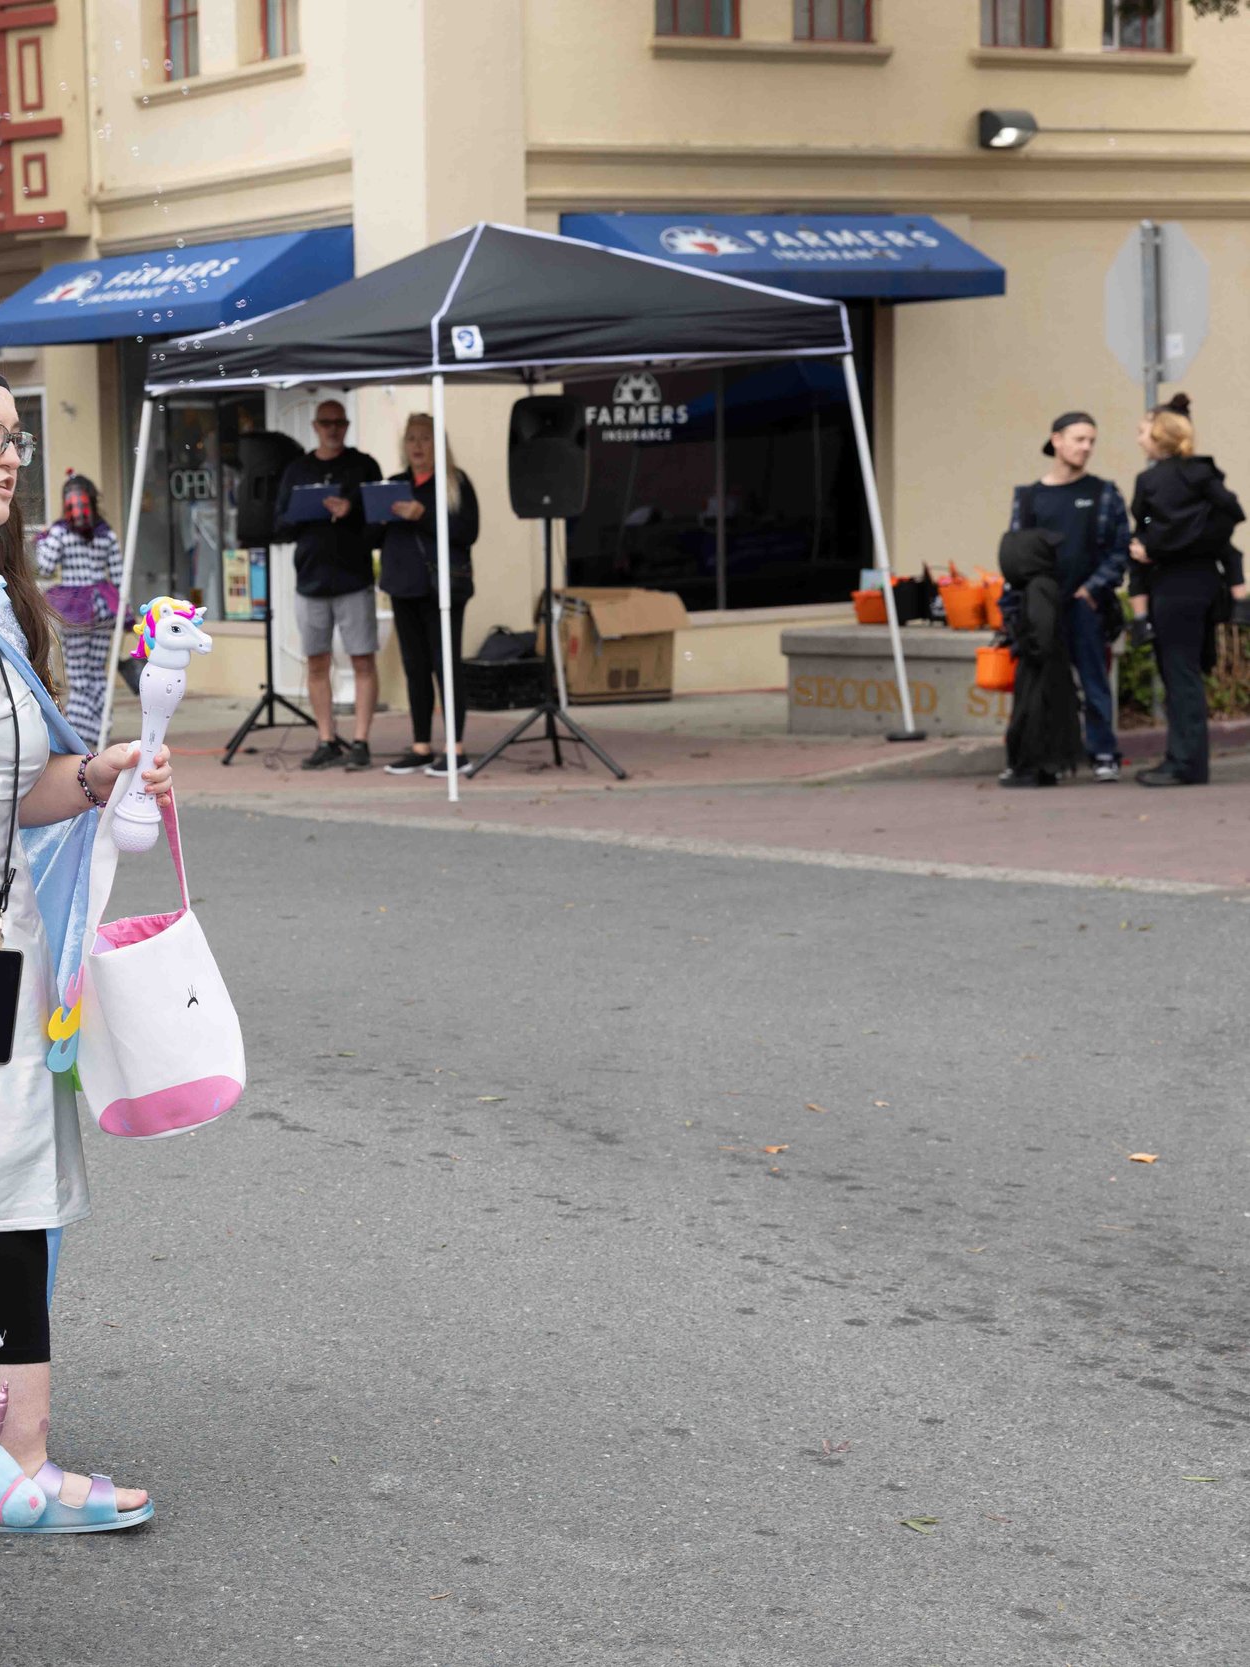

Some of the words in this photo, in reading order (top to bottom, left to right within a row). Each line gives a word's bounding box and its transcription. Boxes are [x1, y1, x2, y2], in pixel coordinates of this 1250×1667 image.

[746, 229, 939, 248] FARMERS
[103, 257, 239, 288] FARMERS
[585, 404, 689, 425] FARMERS
[170, 469, 217, 499] OPEN
[795, 675, 938, 715] SECOND
